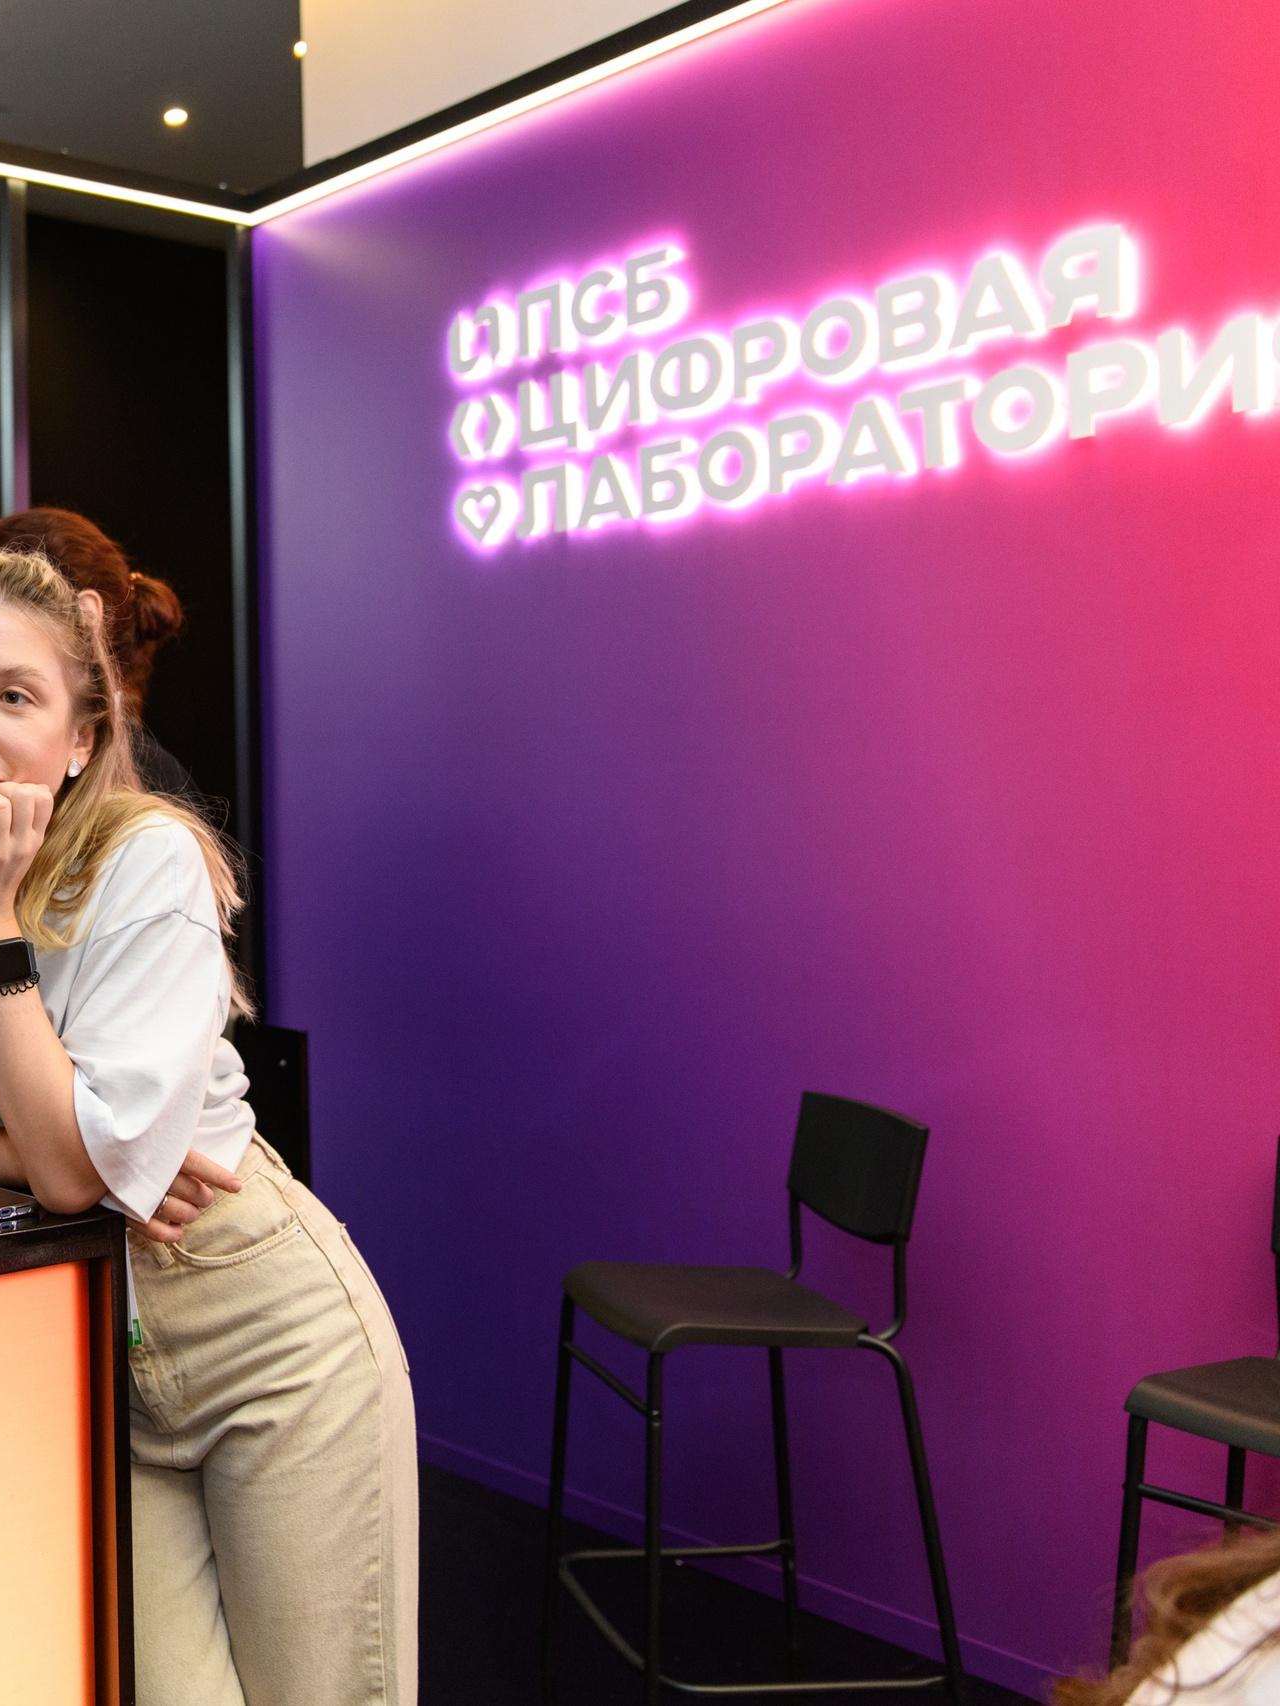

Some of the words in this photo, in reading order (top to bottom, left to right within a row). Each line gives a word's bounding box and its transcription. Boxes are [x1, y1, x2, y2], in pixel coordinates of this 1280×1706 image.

[518, 248, 674, 361] ПСБ
[518, 224, 1122, 454] ЦИФРОВАЯ
[518, 313, 1280, 540] ЛАБОРАТОРИ
